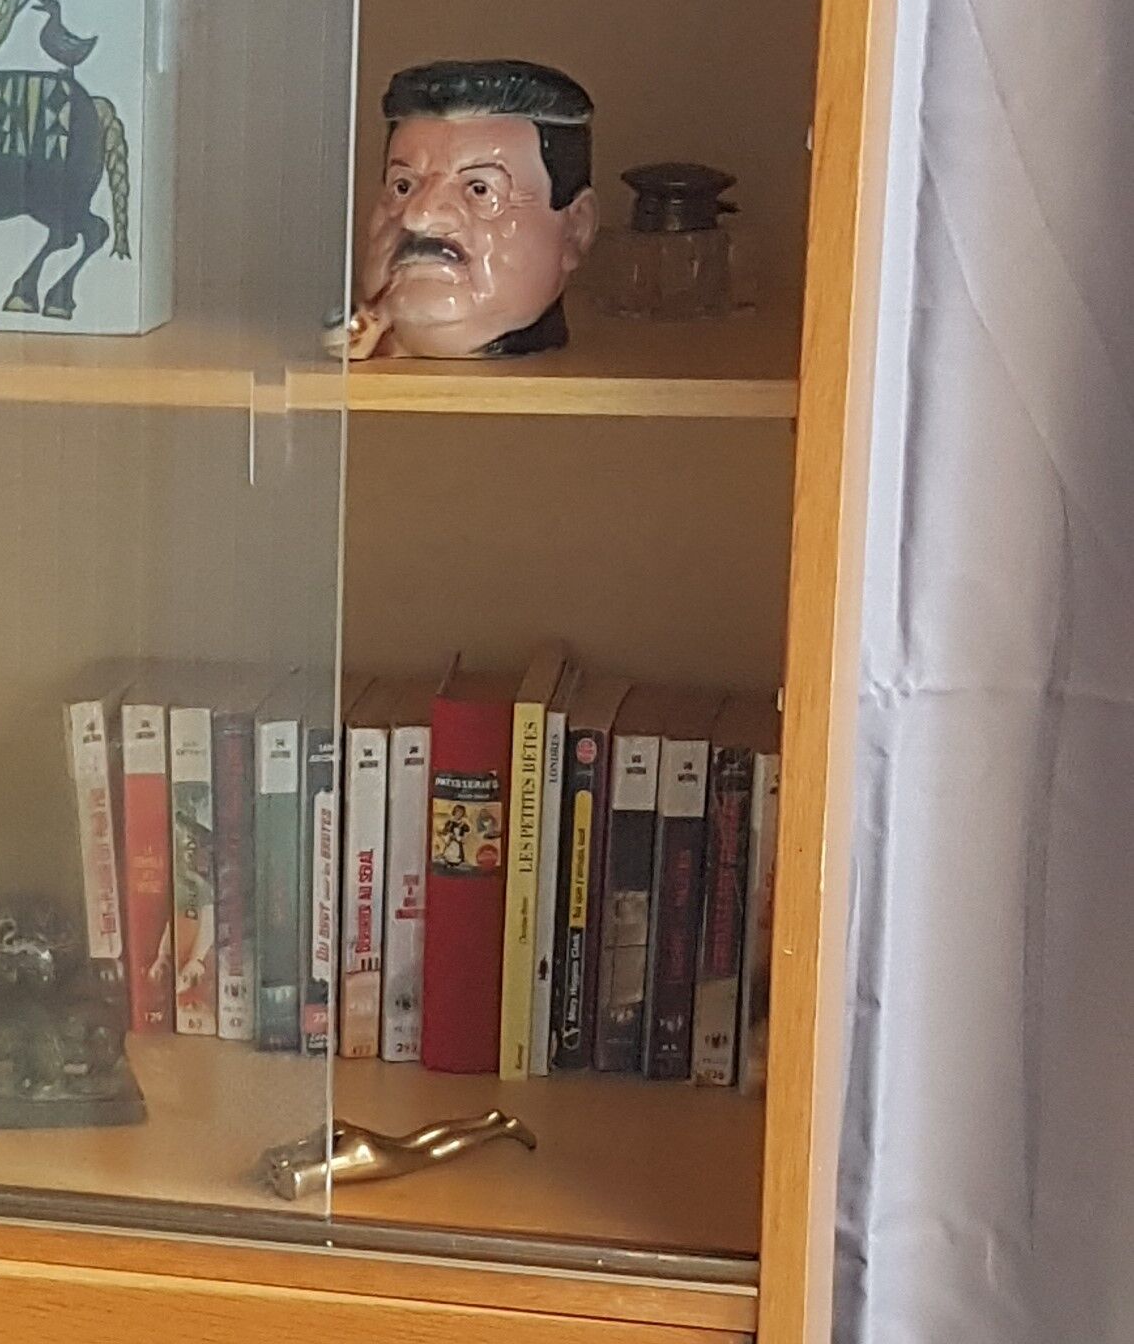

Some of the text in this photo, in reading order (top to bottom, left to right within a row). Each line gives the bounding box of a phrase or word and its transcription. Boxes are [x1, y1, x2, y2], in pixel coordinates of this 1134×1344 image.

[548, 733, 559, 784] LONDRES
[520, 777, 536, 839] PETITES
[518, 842, 533, 873] LES
